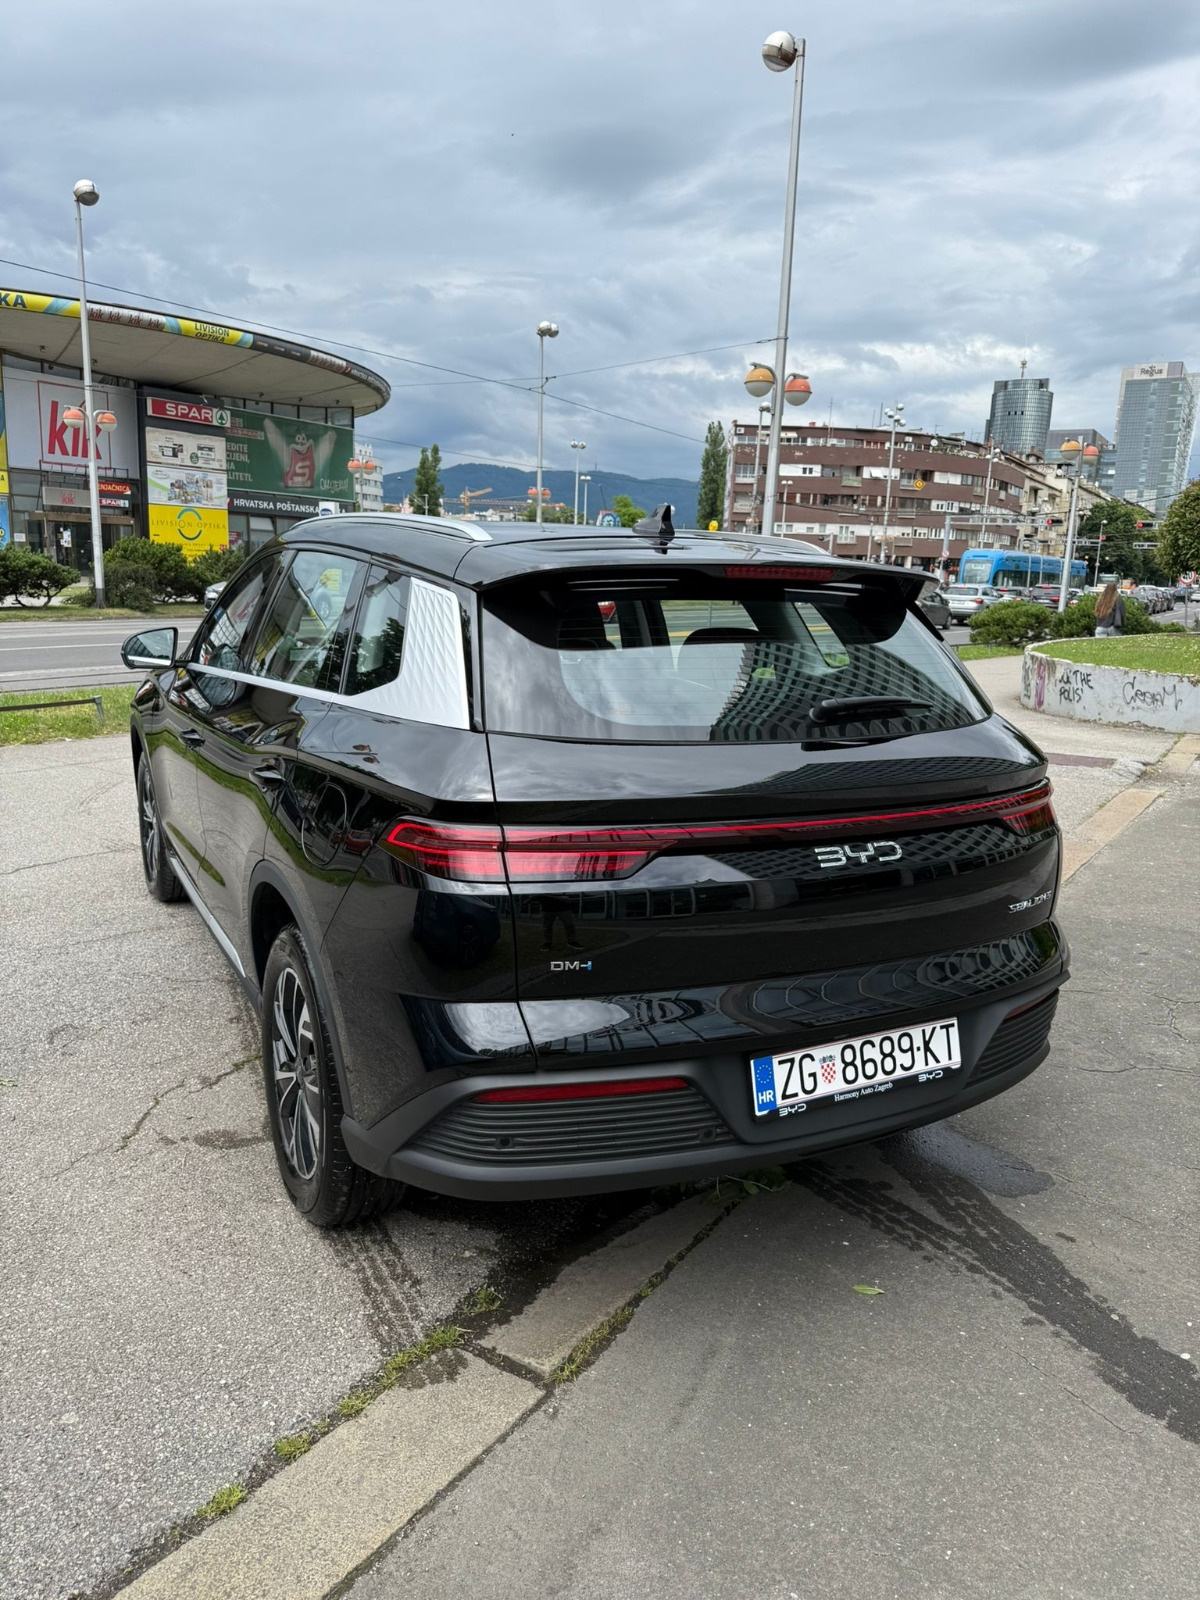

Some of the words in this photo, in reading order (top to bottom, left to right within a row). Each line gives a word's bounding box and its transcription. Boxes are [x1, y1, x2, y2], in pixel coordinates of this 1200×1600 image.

[194, 323, 230, 337] LIVISION
[194, 331, 225, 343] OPTIKA
[1140, 365, 1163, 377] Regus
[165, 402, 213, 423] SPAR
[233, 498, 274, 510] HRVATSKA
[276, 501, 319, 514] POŠTANSKA
[151, 519, 193, 529] LIVISION
[197, 521, 226, 529] OPTIKA
[814, 841, 903, 868] BYD
[777, 1053, 818, 1101] ZG
[918, 1069, 944, 1083] BYD
[758, 1089, 775, 1105] HR
[834, 1089, 860, 1102] Harmony
[860, 1086, 874, 1096] Auto
[874, 1081, 894, 1094] Zagreb
[779, 1103, 807, 1117] BYD
